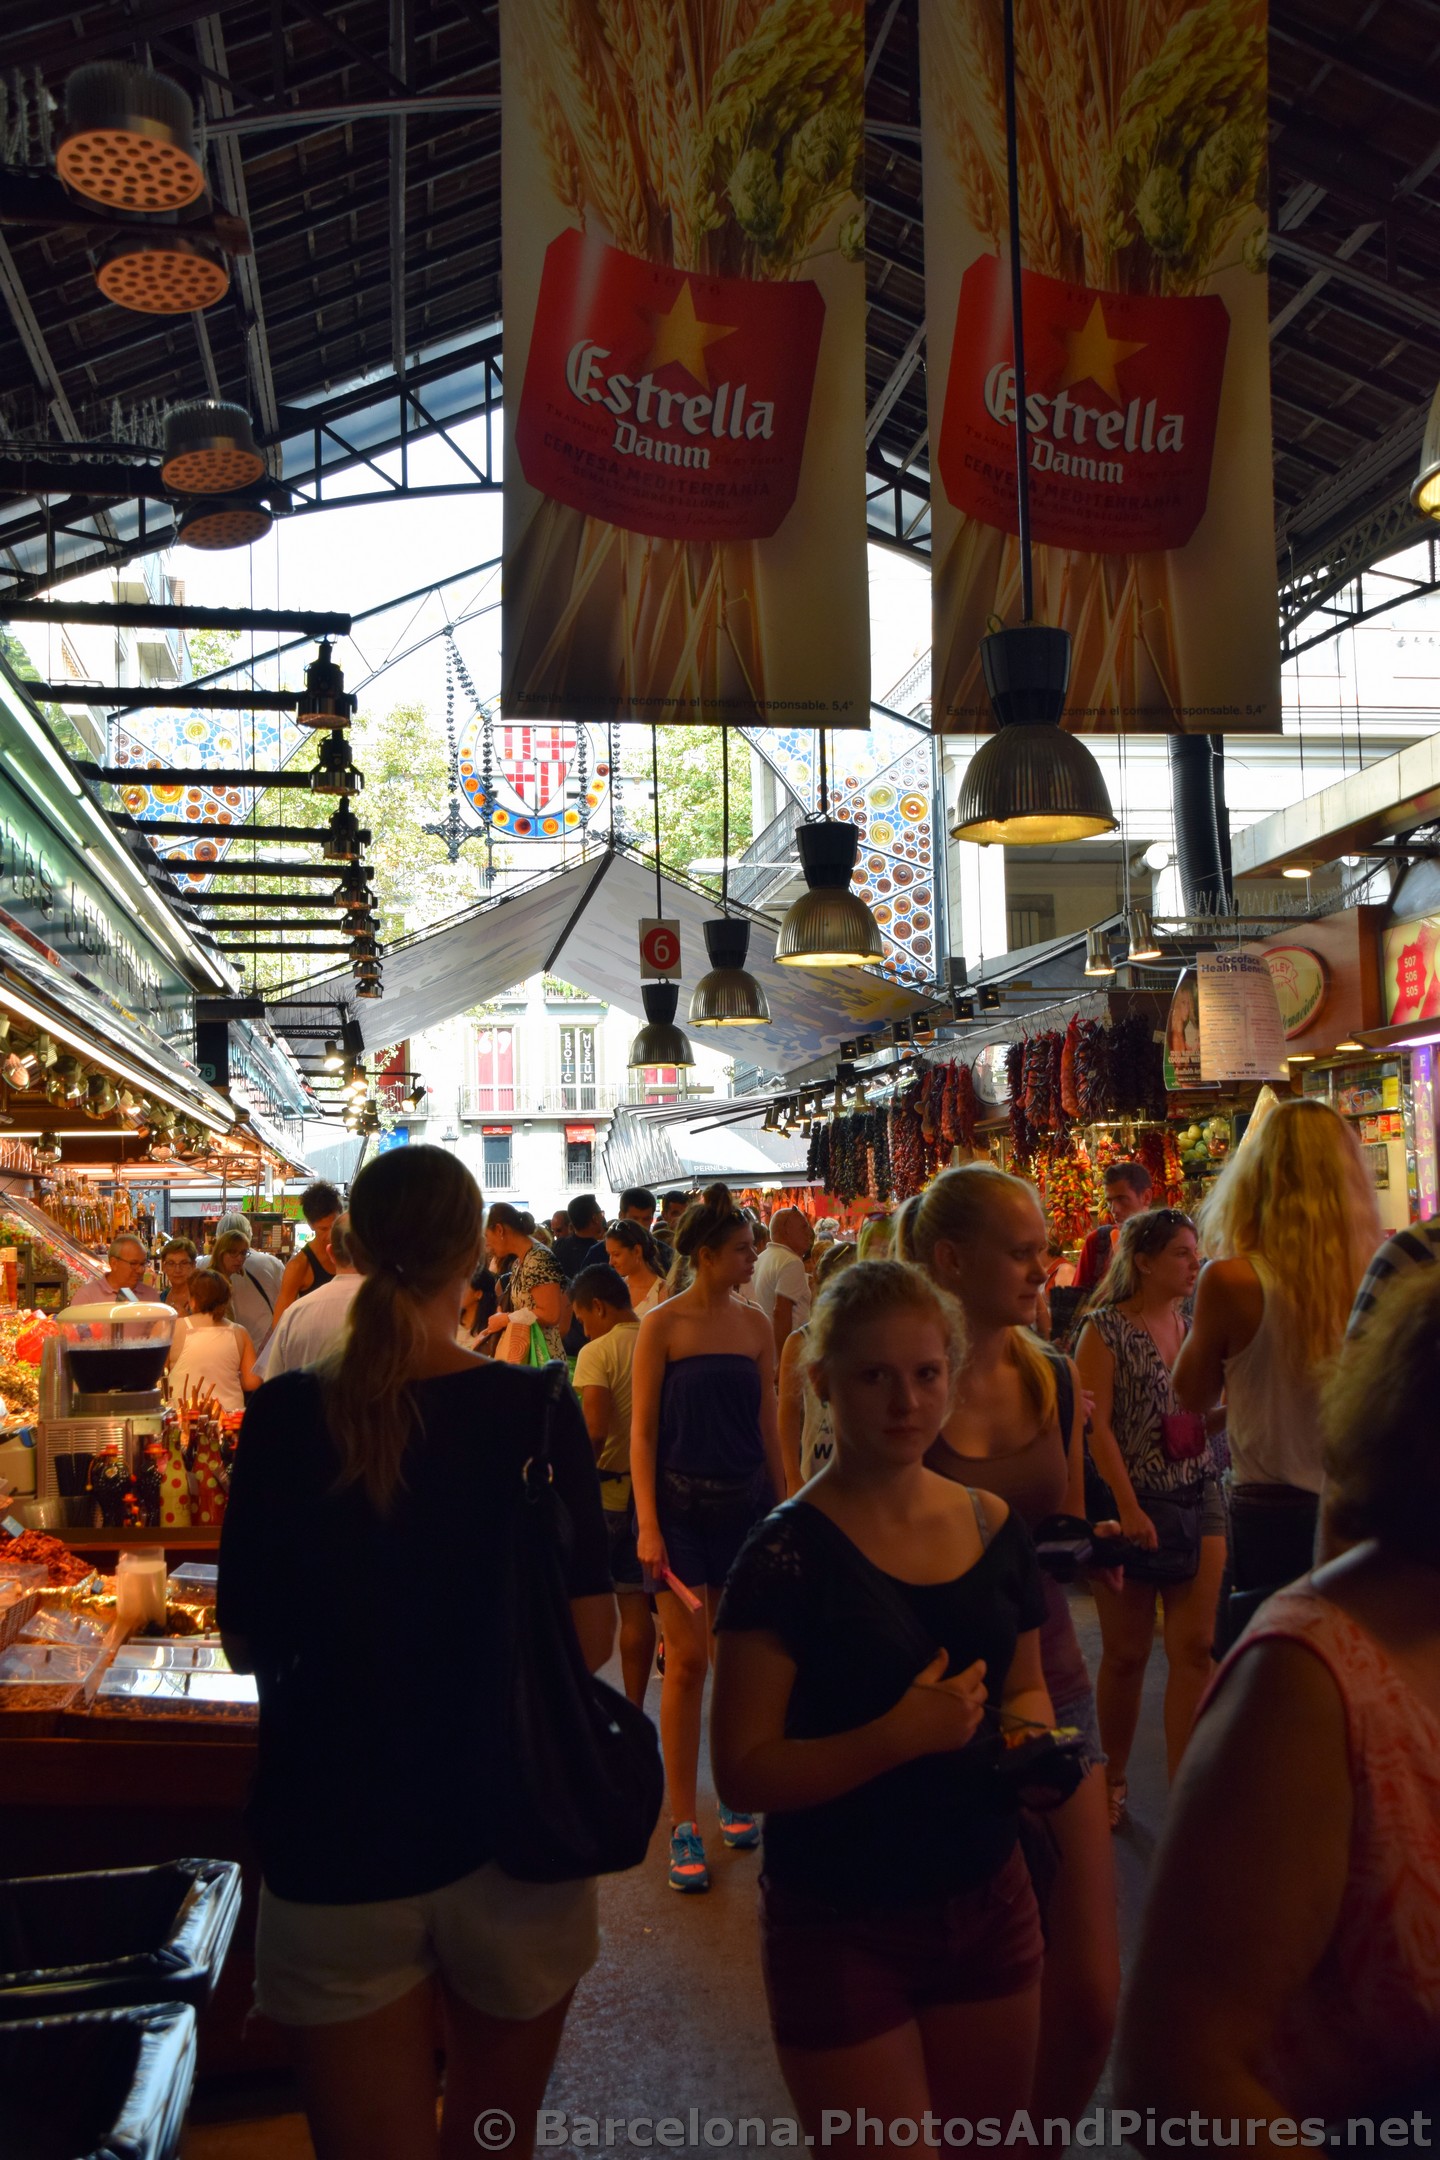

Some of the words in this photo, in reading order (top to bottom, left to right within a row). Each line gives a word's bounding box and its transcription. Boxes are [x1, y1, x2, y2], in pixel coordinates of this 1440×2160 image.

[566, 338, 775, 441] Estrella
[612, 418, 712, 470] Damm
[1030, 435, 1125, 485] Damm
[964, 454, 1038, 493] CERVEA
[628, 695, 686, 706] recomana
[690, 697, 700, 707] el
[755, 699, 829, 711] responsable.
[832, 700, 853, 712] 5,4°
[1110, 705, 1119, 717] el
[654, 935, 670, 963] 6
[1202, 964, 1238, 973] Health
[1404, 955, 1417, 968] 507
[1405, 970, 1418, 983] 506
[1405, 985, 1419, 998] 505
[478, 1031, 512, 1054] 69
[563, 1033, 573, 1083] EROTIC
[583, 1033, 592, 1083] MUSEUM
[694, 1164, 728, 1172] PERNILS
